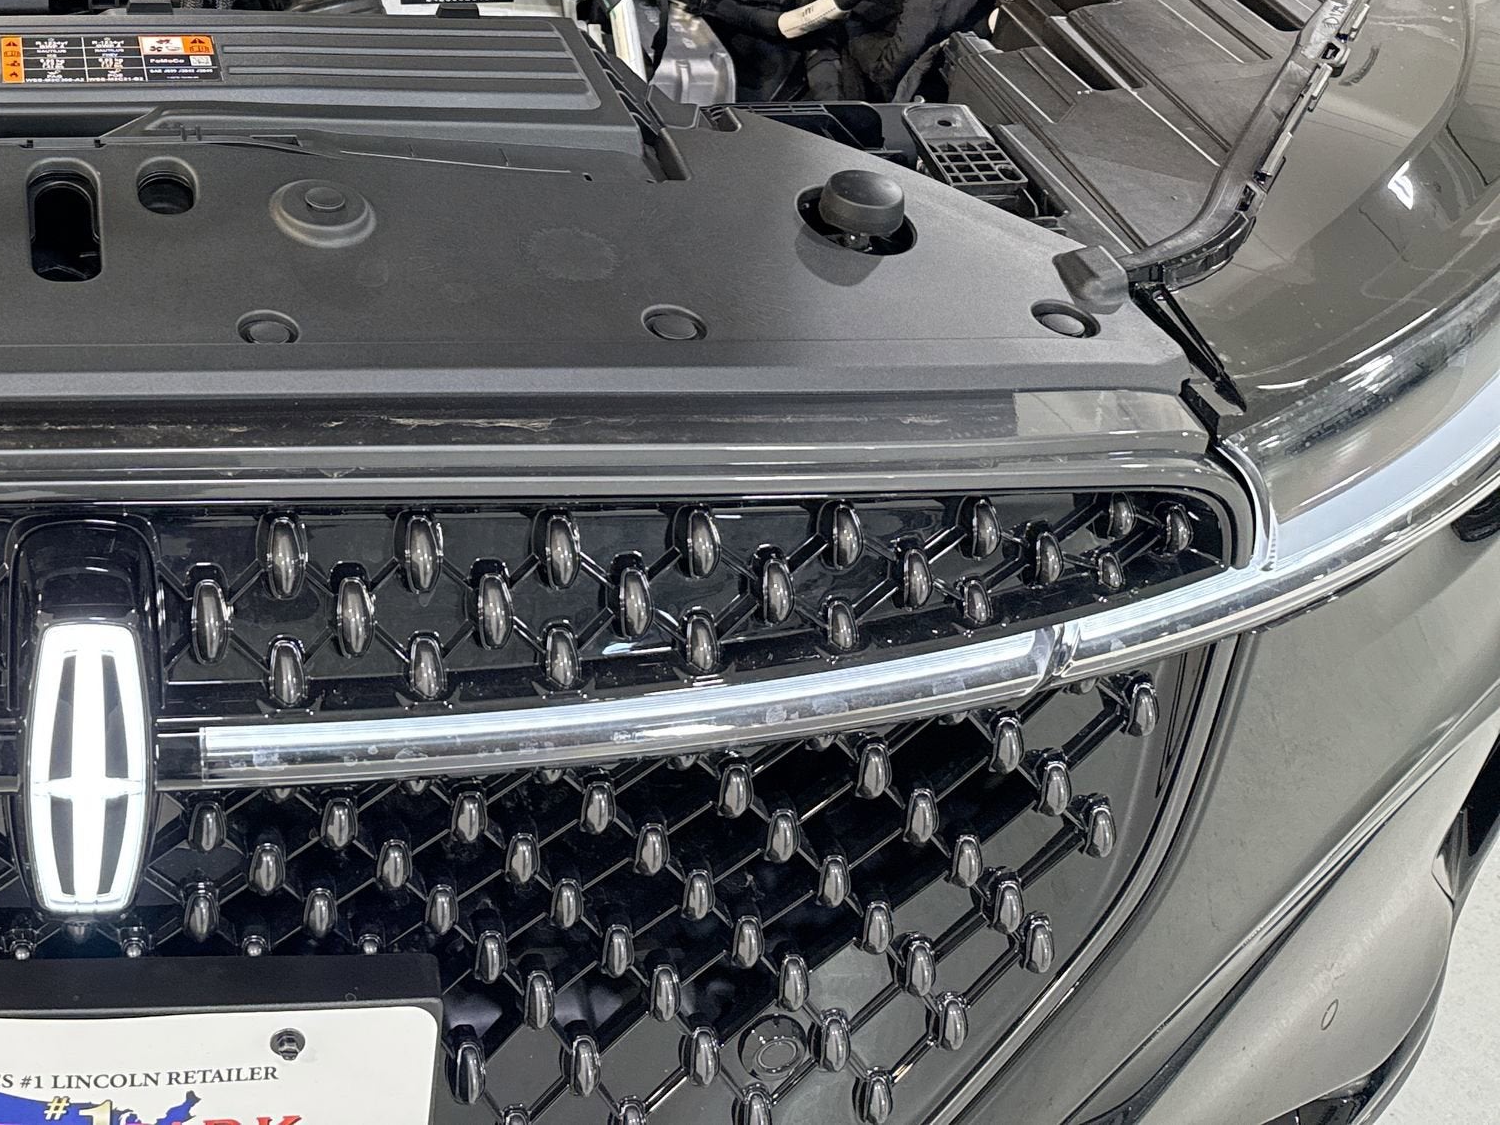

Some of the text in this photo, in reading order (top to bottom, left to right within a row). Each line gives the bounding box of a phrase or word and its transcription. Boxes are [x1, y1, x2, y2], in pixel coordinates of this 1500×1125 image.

[19, 1074, 44, 1089] #1
[51, 1072, 161, 1089] LINCOLN
[166, 1066, 279, 1085] RETAILER
